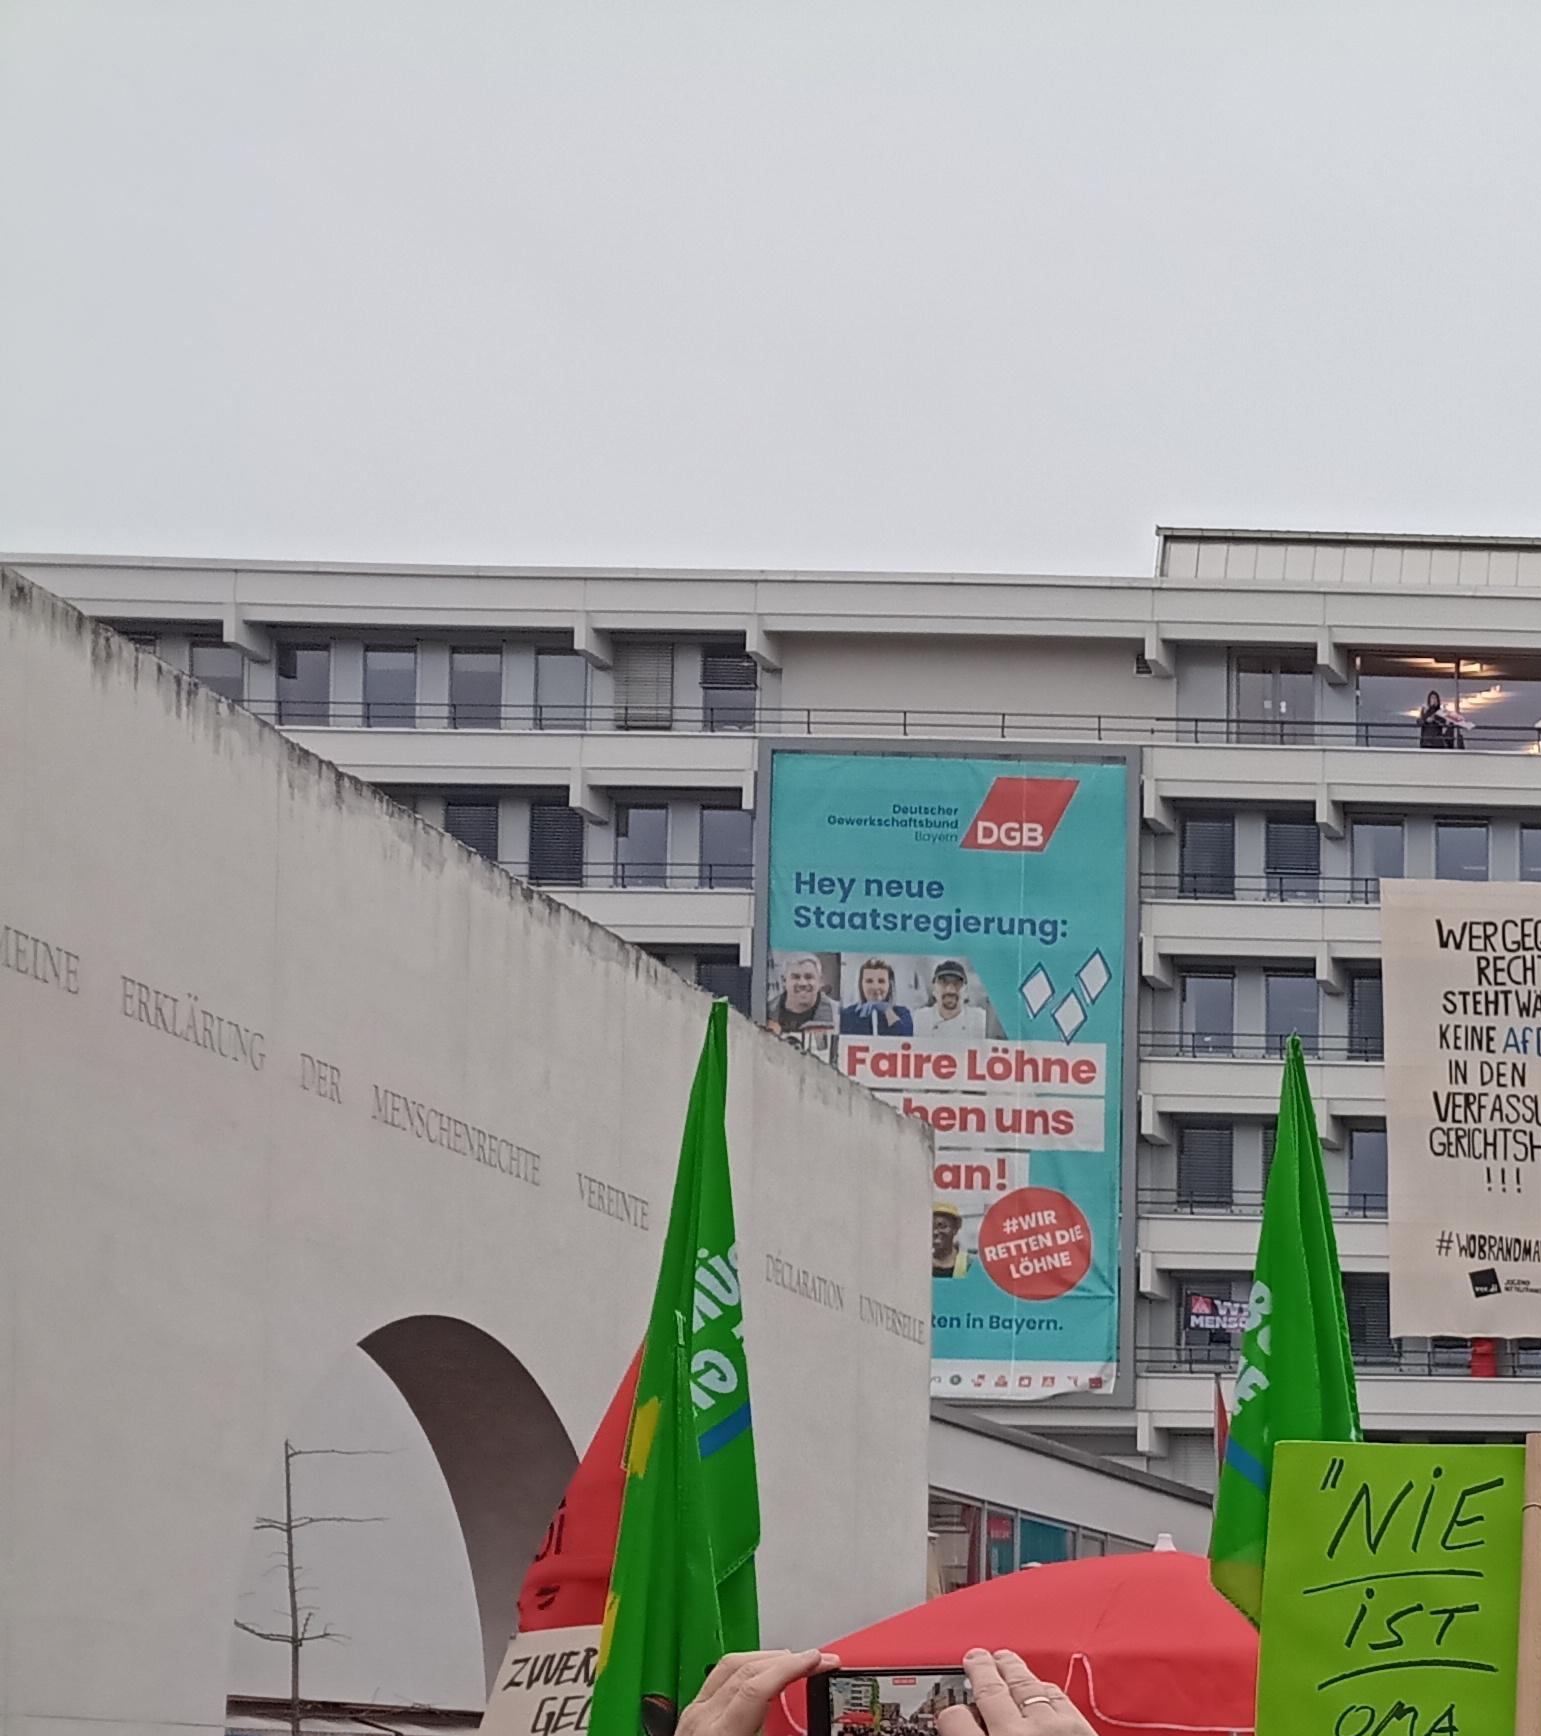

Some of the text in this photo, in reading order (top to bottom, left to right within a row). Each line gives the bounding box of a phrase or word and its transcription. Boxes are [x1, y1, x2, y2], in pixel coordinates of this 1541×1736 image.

[828, 815, 958, 829] Gewerkschaftsbund
[892, 804, 958, 816] Deutscher
[915, 831, 958, 845] Bayern
[977, 821, 1044, 847] DGB
[794, 872, 945, 903] Hey neue
[794, 904, 1068, 946] Staatsregierung:
[1436, 918, 1498, 953] WER
[1442, 991, 1512, 1016] STEHT
[1439, 1024, 1497, 1054] KEINE
[847, 1042, 1097, 1085] Faire Löhne
[1448, 1060, 1526, 1088] IN DEN
[995, 1107, 1075, 1136] uns
[121, 973, 267, 1072] ERKLÄRUNG
[300, 1053, 343, 1105] DER
[372, 1084, 541, 1187] MENSCHENRECHTE
[577, 1172, 649, 1231] VEREINTE
[766, 1250, 845, 1312] DÉCLARATION
[933, 1158, 1008, 1191] an!
[1003, 1210, 1057, 1234] #WIR
[984, 1225, 1084, 1262] RETTEN DIE
[1009, 1251, 1072, 1279] LÖHNE
[966, 1313, 984, 1329] in
[989, 1315, 1064, 1335] Bayern.
